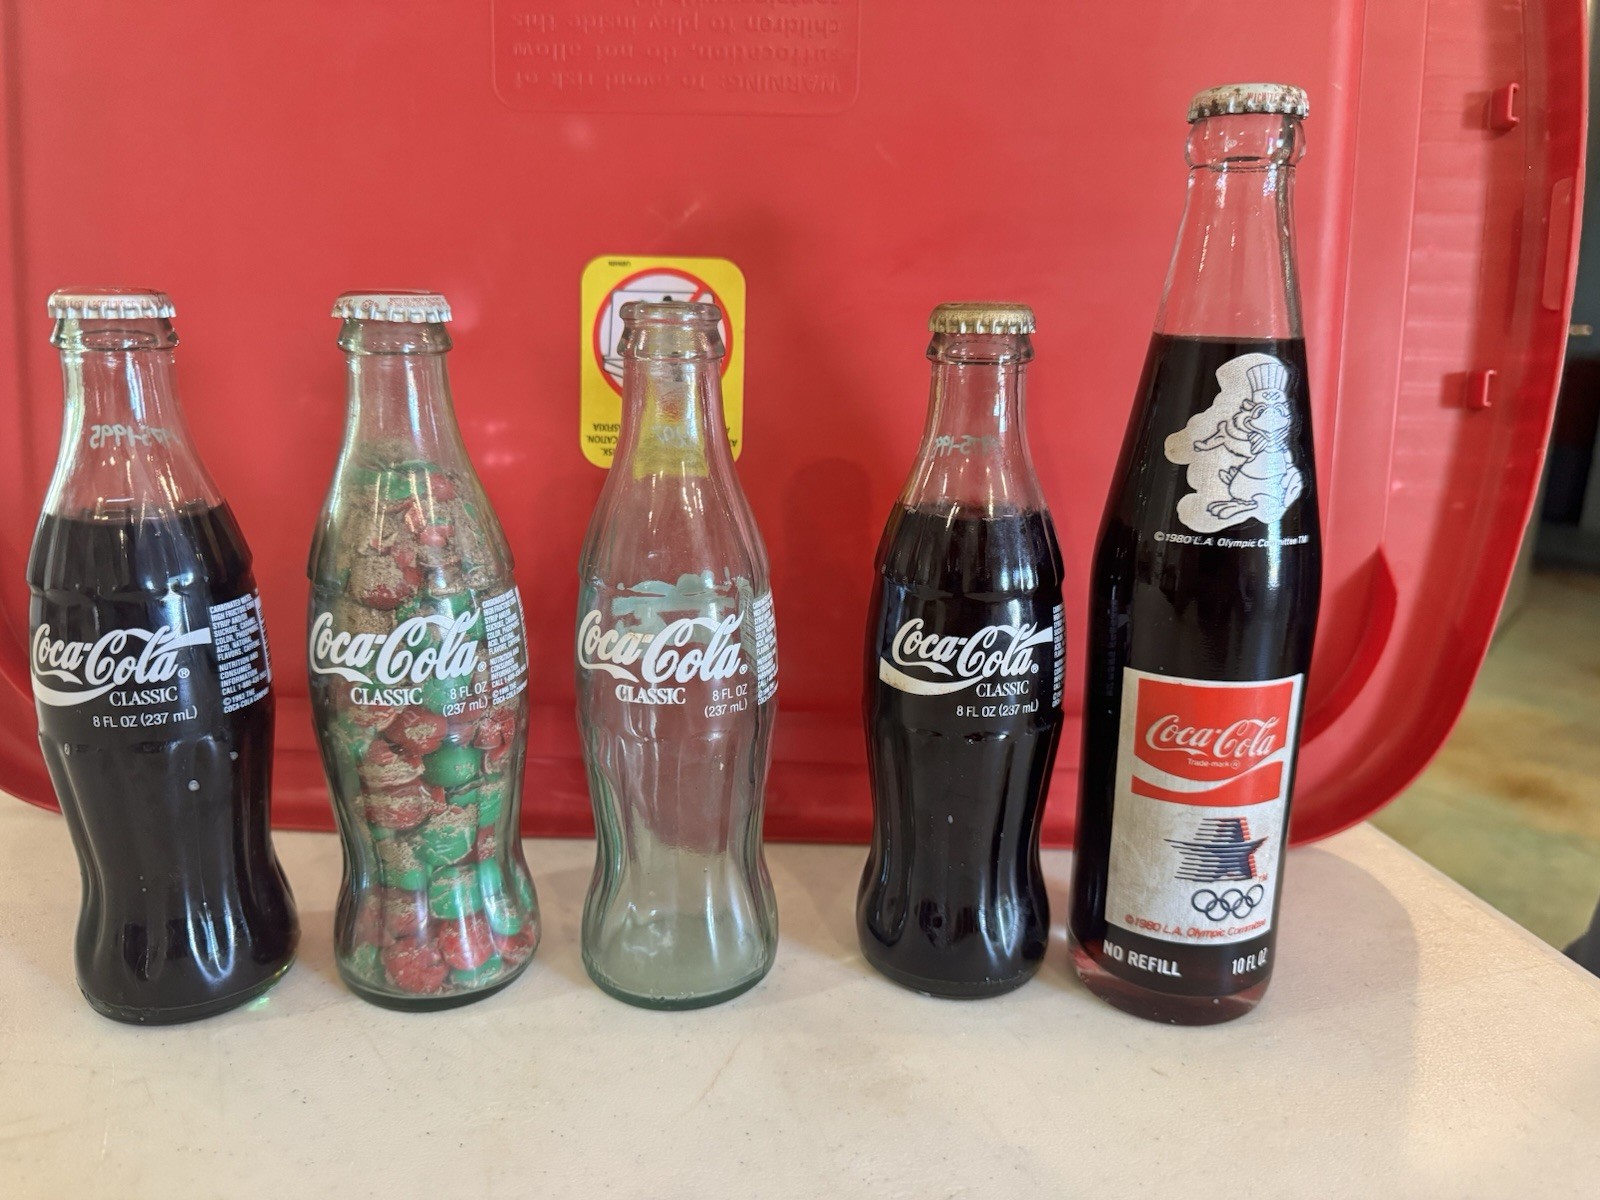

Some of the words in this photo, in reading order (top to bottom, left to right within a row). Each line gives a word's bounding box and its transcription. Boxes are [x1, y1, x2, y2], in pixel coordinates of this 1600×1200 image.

[512, 14, 554, 33] this
[711, 17, 735, 35] to
[746, 17, 840, 38] children
[513, 43, 582, 63] allow
[595, 45, 633, 62] not
[647, 45, 677, 64] do
[514, 71, 538, 90] of
[551, 72, 593, 91] risk
[605, 72, 669, 92] avoid
[719, 73, 841, 94] WARNING:
[1217, 537, 1256, 549] Olympic
[212, 619, 231, 630] SYRUP
[33, 623, 182, 686] Coca-Cola
[309, 607, 480, 685] Coca-Cola
[577, 609, 745, 684] Coca-Cola
[892, 618, 1037, 678] Coca-Cola
[219, 655, 250, 672] NUTRITION
[220, 663, 252, 680] CONSUMER
[221, 668, 258, 688] INFORMATION
[109, 686, 179, 708] CLASSIC
[222, 684, 237, 696] CALL
[351, 687, 423, 706] CLASSIC
[450, 688, 457, 700] 8
[460, 685, 471, 697] FL
[474, 681, 489, 694] OZ
[615, 684, 686, 705] CLASSIC
[712, 690, 720, 701] 8
[721, 687, 733, 699] FL
[735, 683, 748, 696] OZ
[976, 680, 1030, 698] CLASSIC
[442, 702, 466, 718] (237
[469, 695, 488, 712] mL)
[704, 703, 727, 719] (237
[730, 700, 748, 714] mL)
[956, 705, 964, 717] 8
[967, 705, 979, 718] FL
[981, 705, 996, 718] OZ
[998, 703, 1019, 718] (237
[1022, 699, 1039, 714] mL)
[92, 715, 101, 728] 8
[104, 716, 118, 728] FL
[120, 715, 138, 728] OZ
[140, 714, 168, 728] (237
[173, 705, 198, 722] mL)
[1145, 714, 1280, 759] Coca-Cola
[1163, 925, 1182, 936] L.A.
[1187, 927, 1226, 939] Olympic
[1228, 918, 1267, 936] Committee
[1103, 939, 1124, 962] NO
[1128, 950, 1182, 977] REFILL
[1232, 958, 1244, 975] 10
[1246, 955, 1256, 972] FL
[1257, 947, 1267, 965] OZ
